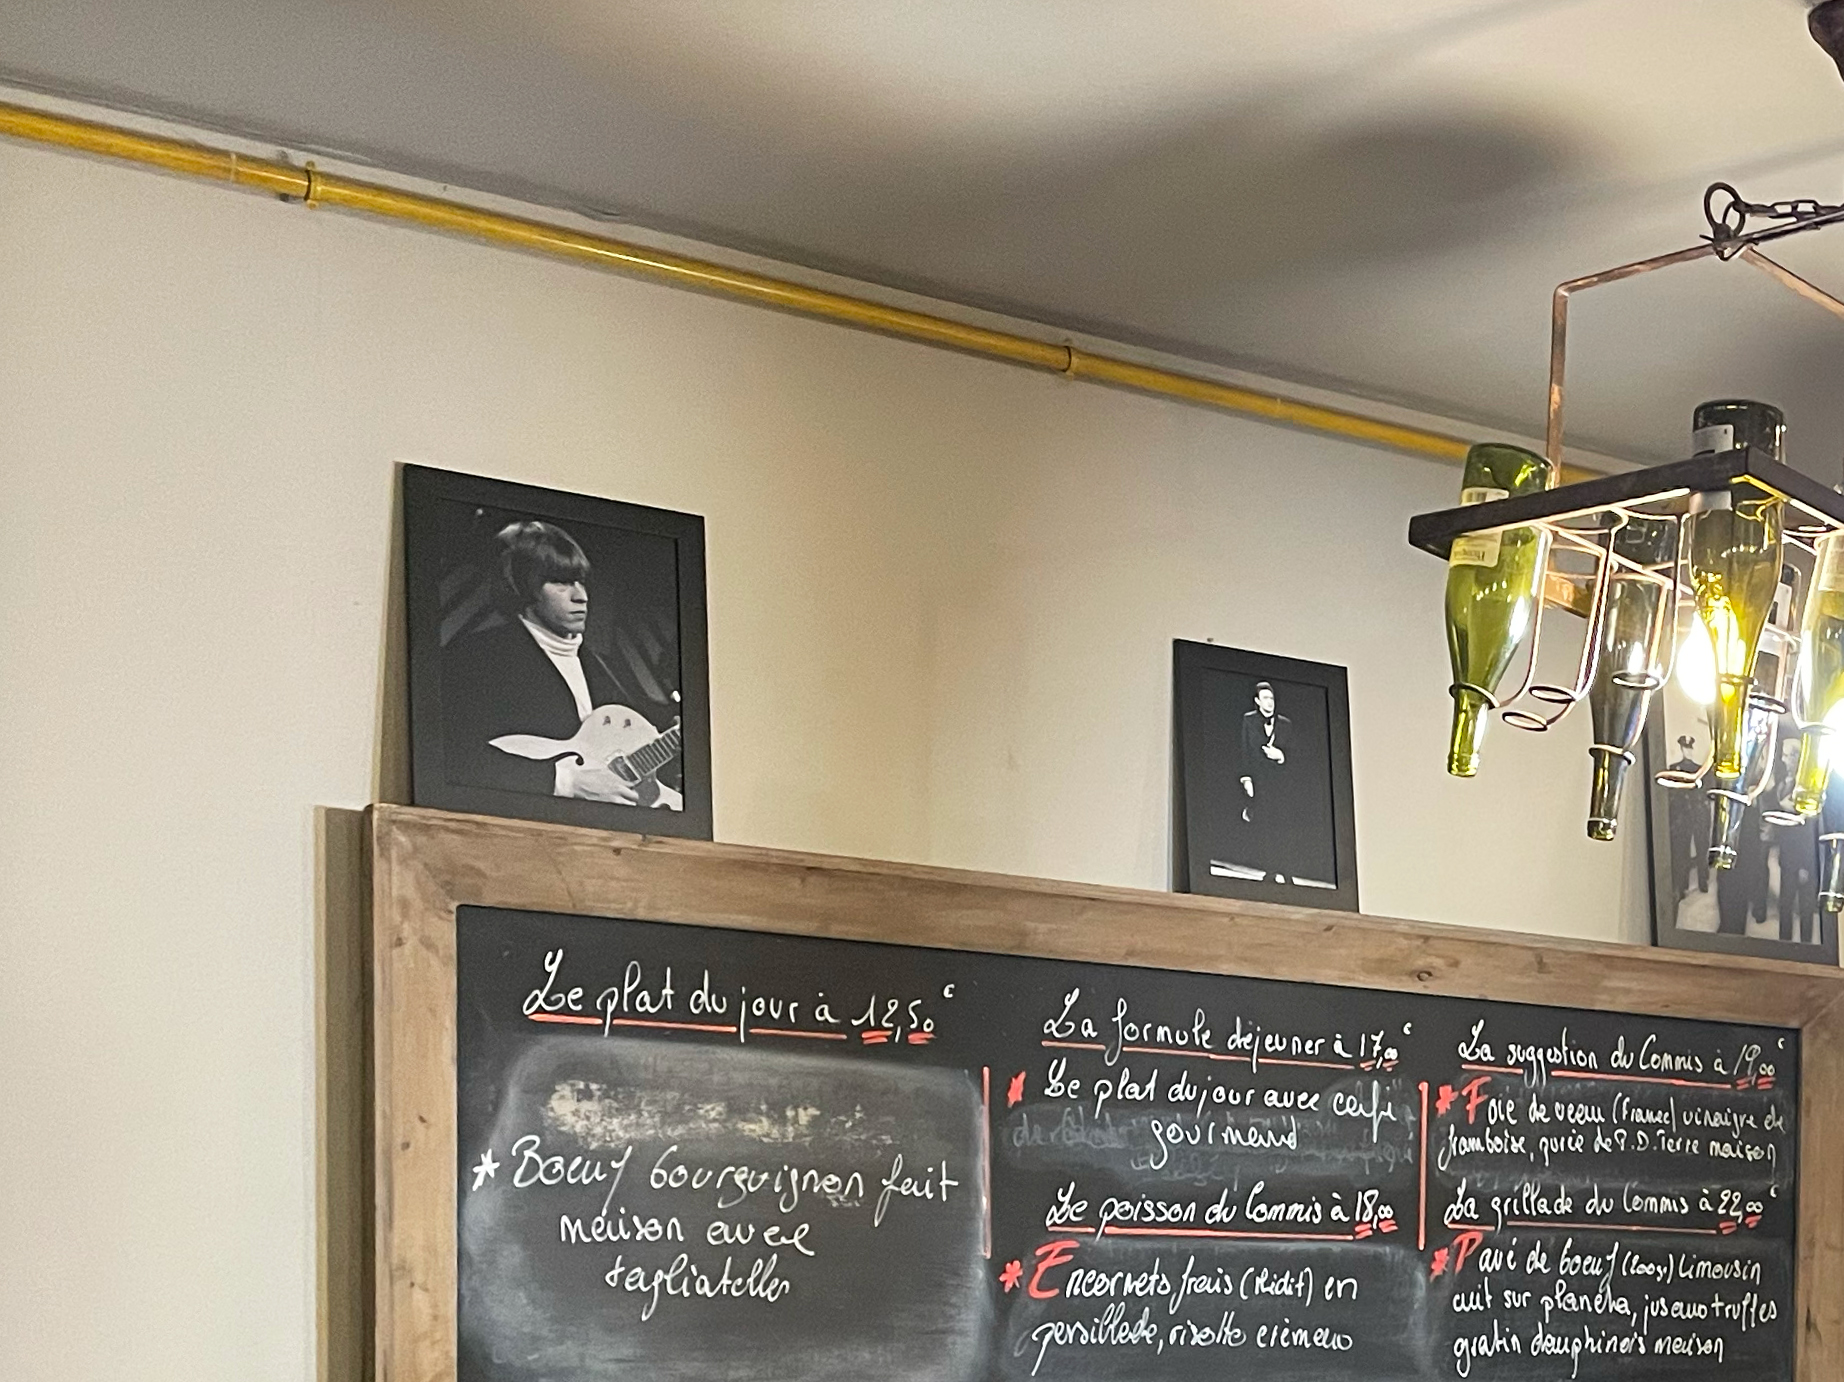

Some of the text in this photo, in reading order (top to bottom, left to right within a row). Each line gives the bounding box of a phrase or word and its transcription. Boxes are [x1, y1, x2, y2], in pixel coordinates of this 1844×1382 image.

[523, 949, 583, 1015] Le
[597, 961, 674, 1036] plat
[689, 970, 727, 1015] du
[739, 987, 799, 1042] jour
[815, 992, 840, 1023] à
[1043, 988, 1098, 1038] La
[1104, 998, 1213, 1066] formule
[1458, 1019, 1495, 1062] La
[1507, 1027, 1598, 1089] suggestion
[1610, 1035, 1634, 1069] du
[1639, 1034, 1703, 1073] Commis
[1045, 1058, 1079, 1099] Le
[1095, 1070, 1158, 1119] plat
[1264, 1092, 1320, 1111] avec
[1461, 1076, 1518, 1125] Foie
[1529, 1093, 1551, 1123] de
[1683, 1107, 1758, 1139] vinaigre
[1150, 1115, 1300, 1170] gourmand
[1709, 1140, 1777, 1183] maison
[650, 1145, 864, 1213] bourguignon
[881, 1154, 958, 1227] fait
[1045, 1182, 1088, 1224] Le
[1095, 1196, 1197, 1244] poisson
[1205, 1188, 1238, 1225] du
[1246, 1180, 1322, 1224] Commis
[1330, 1195, 1350, 1222] à
[1443, 1178, 1479, 1224] La
[1492, 1184, 1573, 1230] grillade
[1585, 1186, 1614, 1214] du
[1623, 1182, 1689, 1214] Commis
[1699, 1189, 1715, 1212] à
[560, 1210, 815, 1255] maison avec
[1526, 1246, 1551, 1275] de
[1169, 1255, 1233, 1315] frais
[1325, 1276, 1358, 1301] en
[1452, 1277, 1493, 1312] cuit
[1503, 1289, 1532, 1309] sur
[1713, 1293, 1778, 1332] truffes
[1453, 1319, 1725, 1379] gratin dauphinois maison
